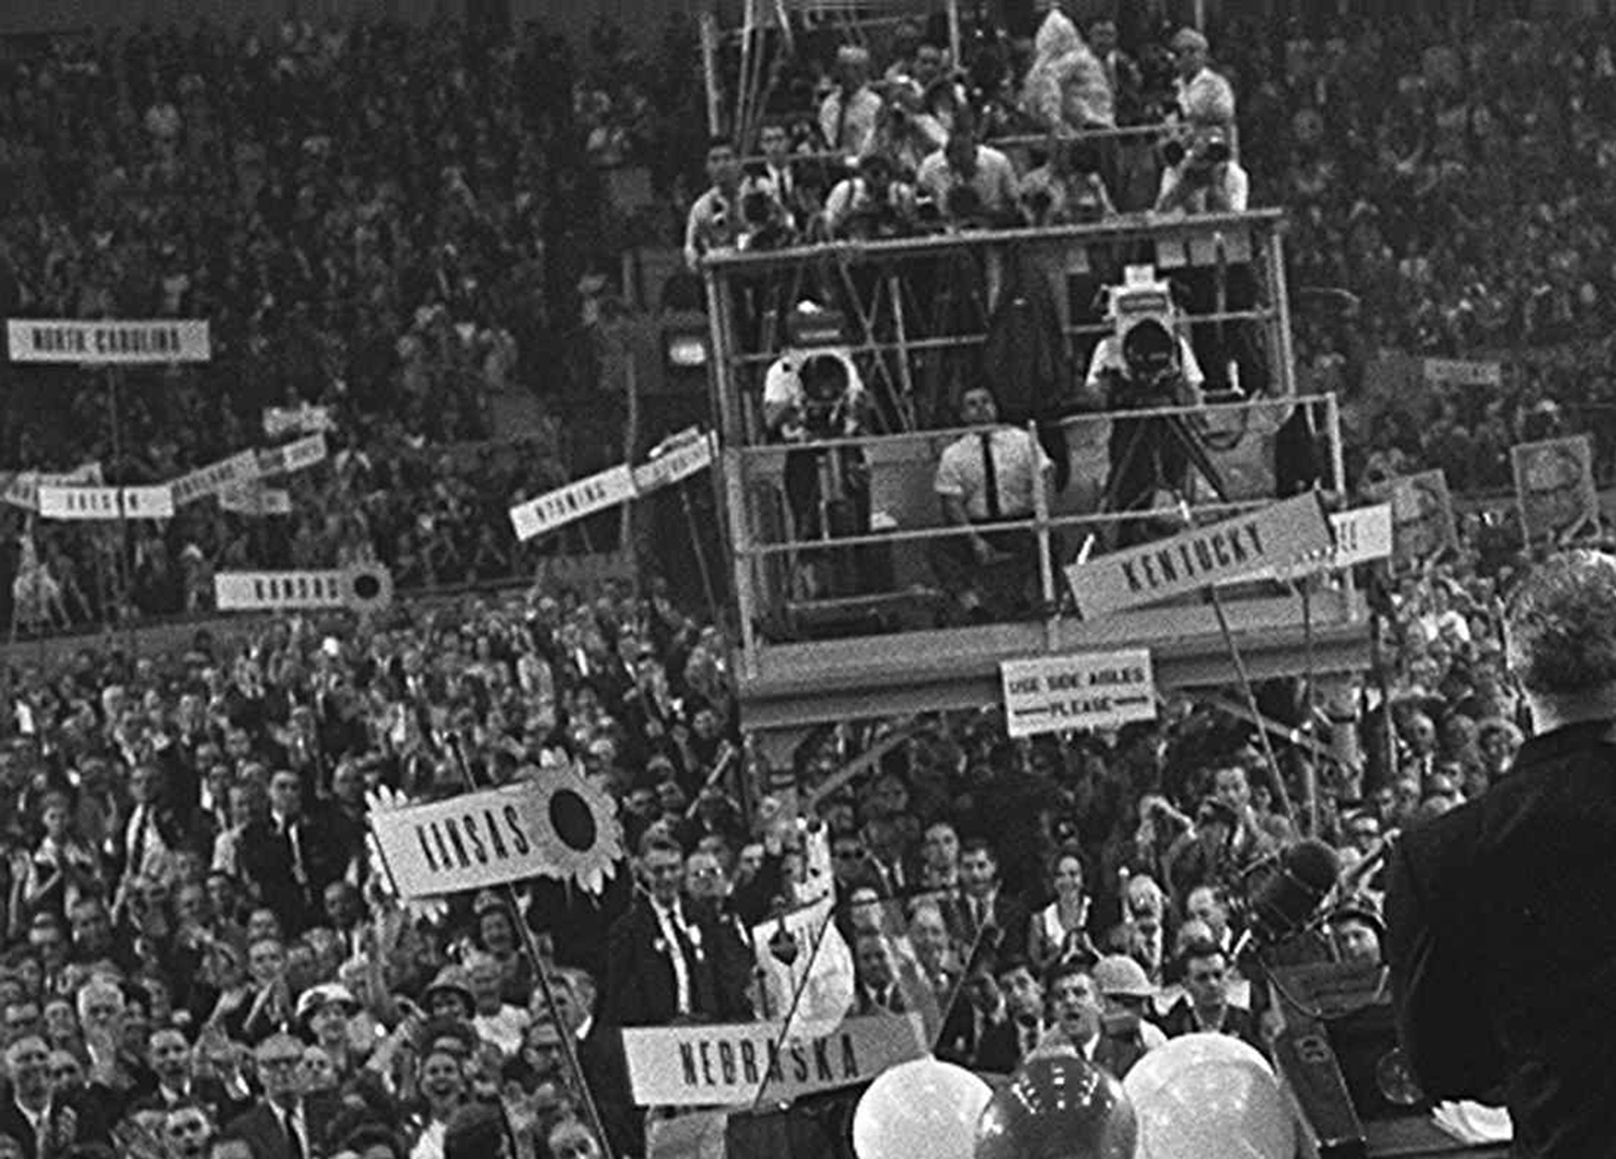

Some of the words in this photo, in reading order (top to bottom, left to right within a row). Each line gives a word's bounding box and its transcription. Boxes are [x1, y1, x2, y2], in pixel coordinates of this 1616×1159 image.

[1121, 522, 1264, 593] KENTUCKY
[253, 577, 340, 602] KANSAS
[1008, 677, 1040, 695] USE
[1046, 671, 1081, 692] SIDE
[1088, 666, 1147, 687] AISLES
[1049, 696, 1112, 717] PLEASE
[415, 804, 531, 873] KANSAS
[679, 1031, 860, 1087] NEBRASKA
